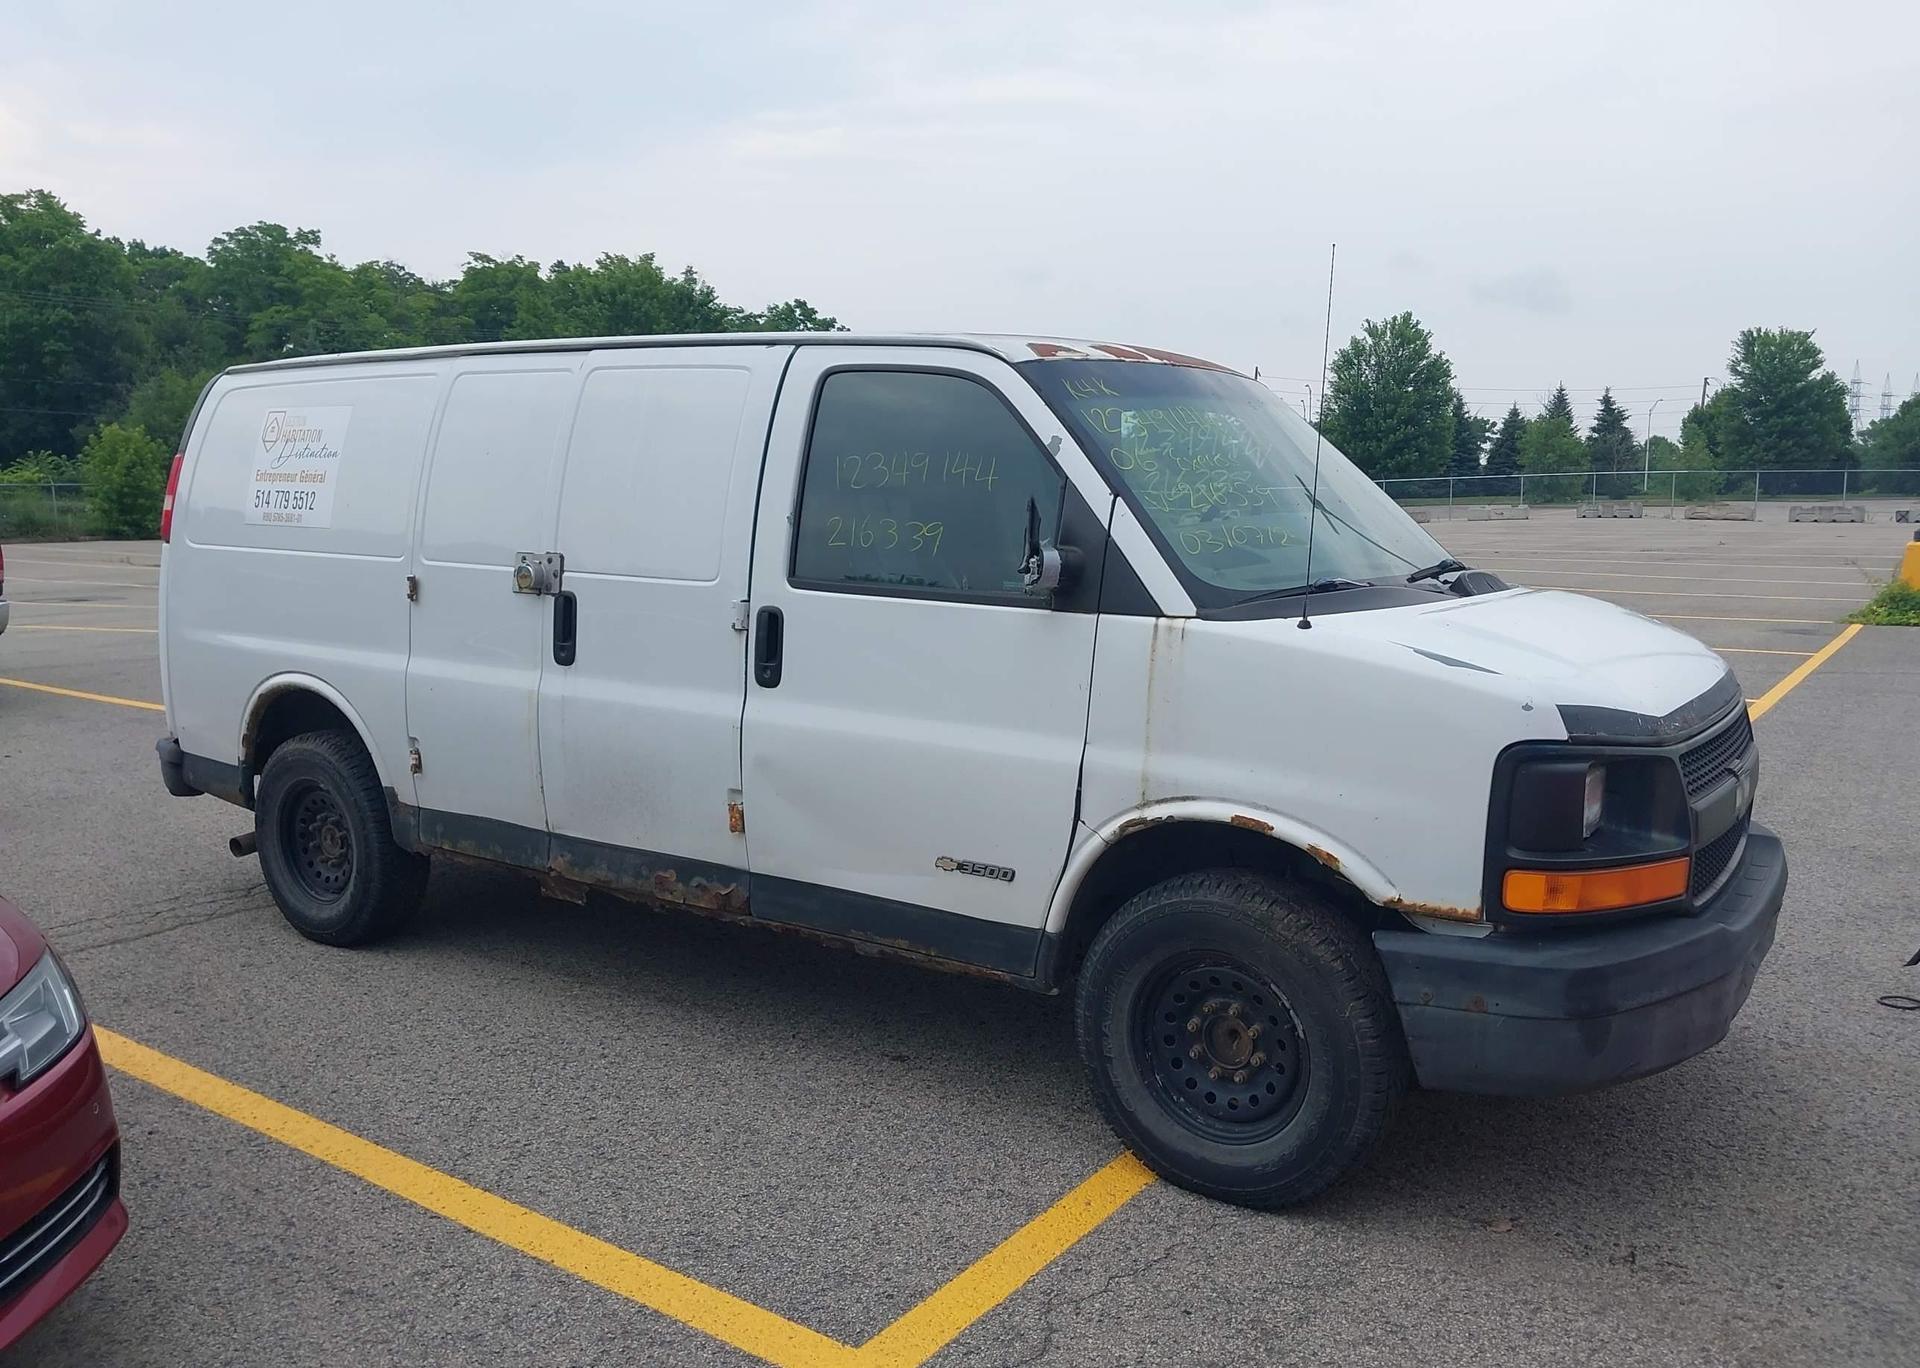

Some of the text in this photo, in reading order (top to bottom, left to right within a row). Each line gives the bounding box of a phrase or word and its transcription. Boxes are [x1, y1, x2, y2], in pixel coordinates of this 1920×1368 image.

[280, 429, 323, 443] HABITATION
[255, 469, 327, 484] Entrepreneur Général
[254, 489, 316, 511] 514 779 5512
[826, 513, 945, 559] 216339
[959, 861, 1015, 882] 3500
